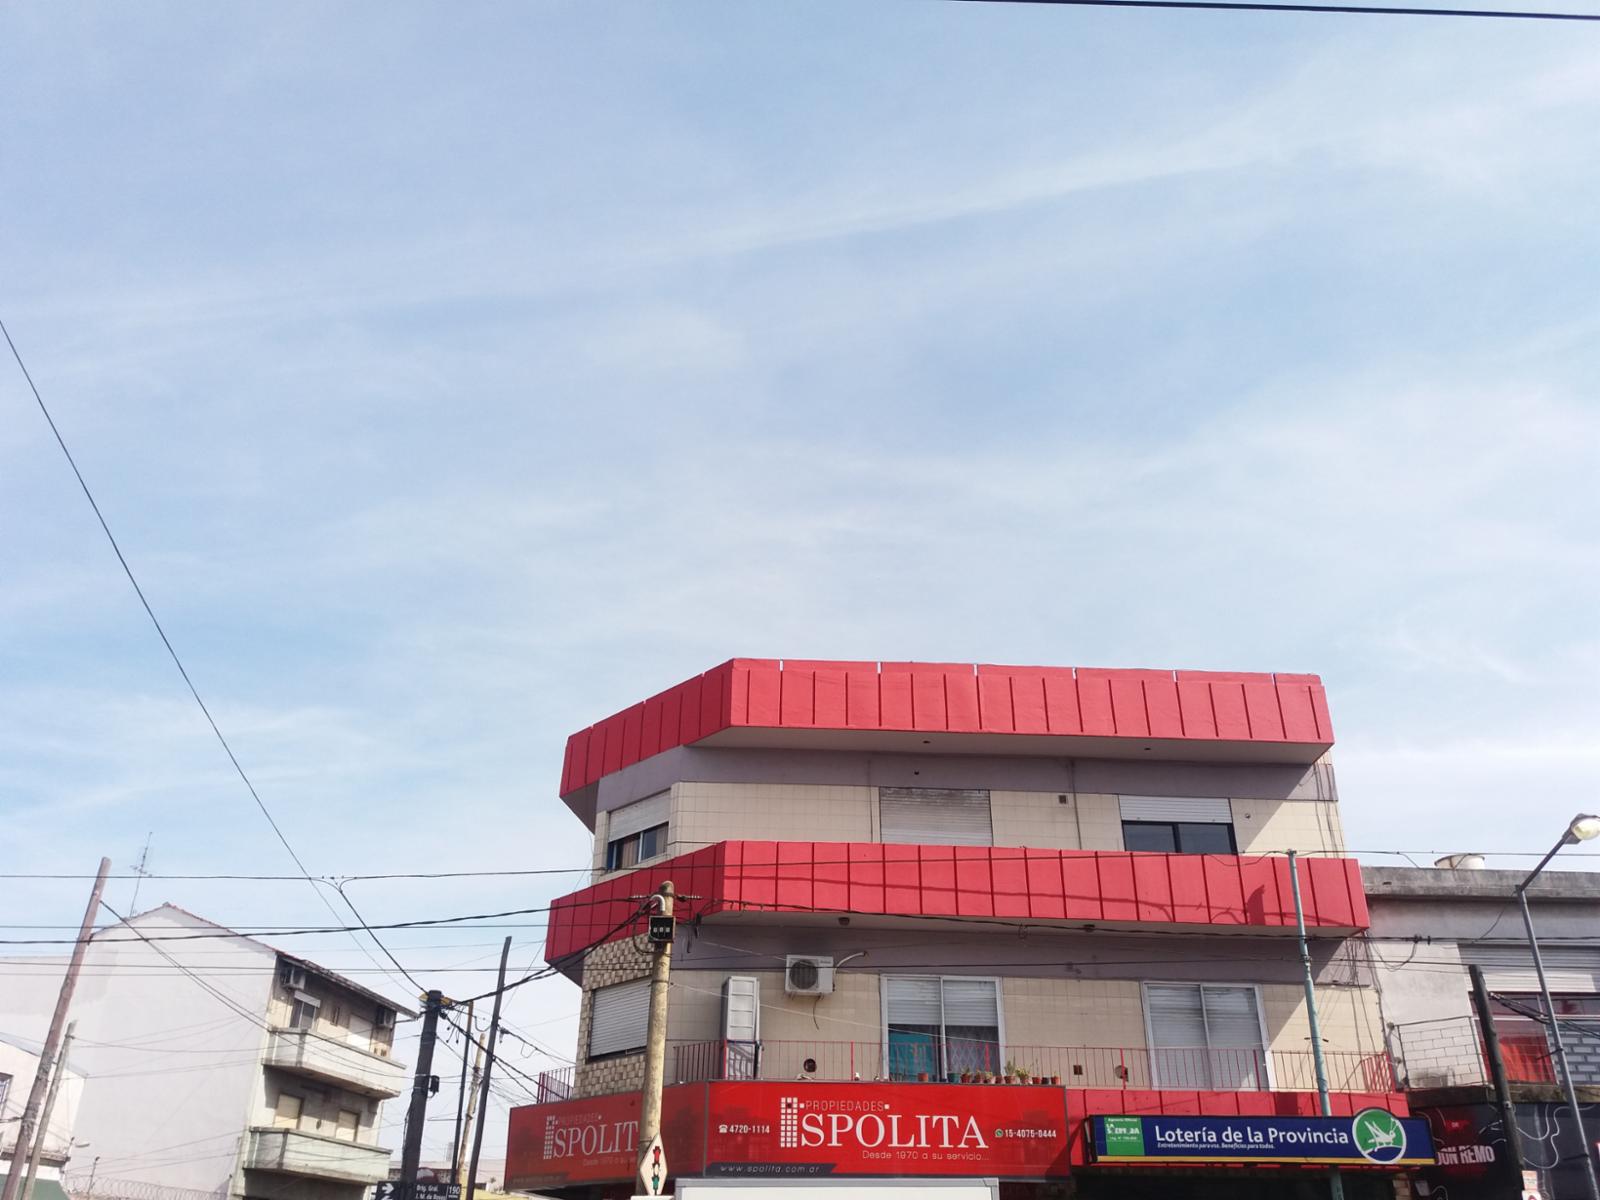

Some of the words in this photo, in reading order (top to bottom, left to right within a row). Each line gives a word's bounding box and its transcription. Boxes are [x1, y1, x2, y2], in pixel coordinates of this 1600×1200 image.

[805, 1100, 885, 1112] PROPIEDADES
[729, 1124, 770, 1134] 4720-1114
[801, 1113, 989, 1149] SPOLITA
[1155, 1125, 1218, 1142] Lotería
[1222, 1125, 1243, 1143] de
[1247, 1126, 1264, 1143] la
[1267, 1127, 1349, 1144] Provincia
[553, 1120, 639, 1158] SPOLIT
[862, 1150, 892, 1159] Desde
[896, 1151, 918, 1160] 1970
[1459, 1145, 1496, 1164] REMO
